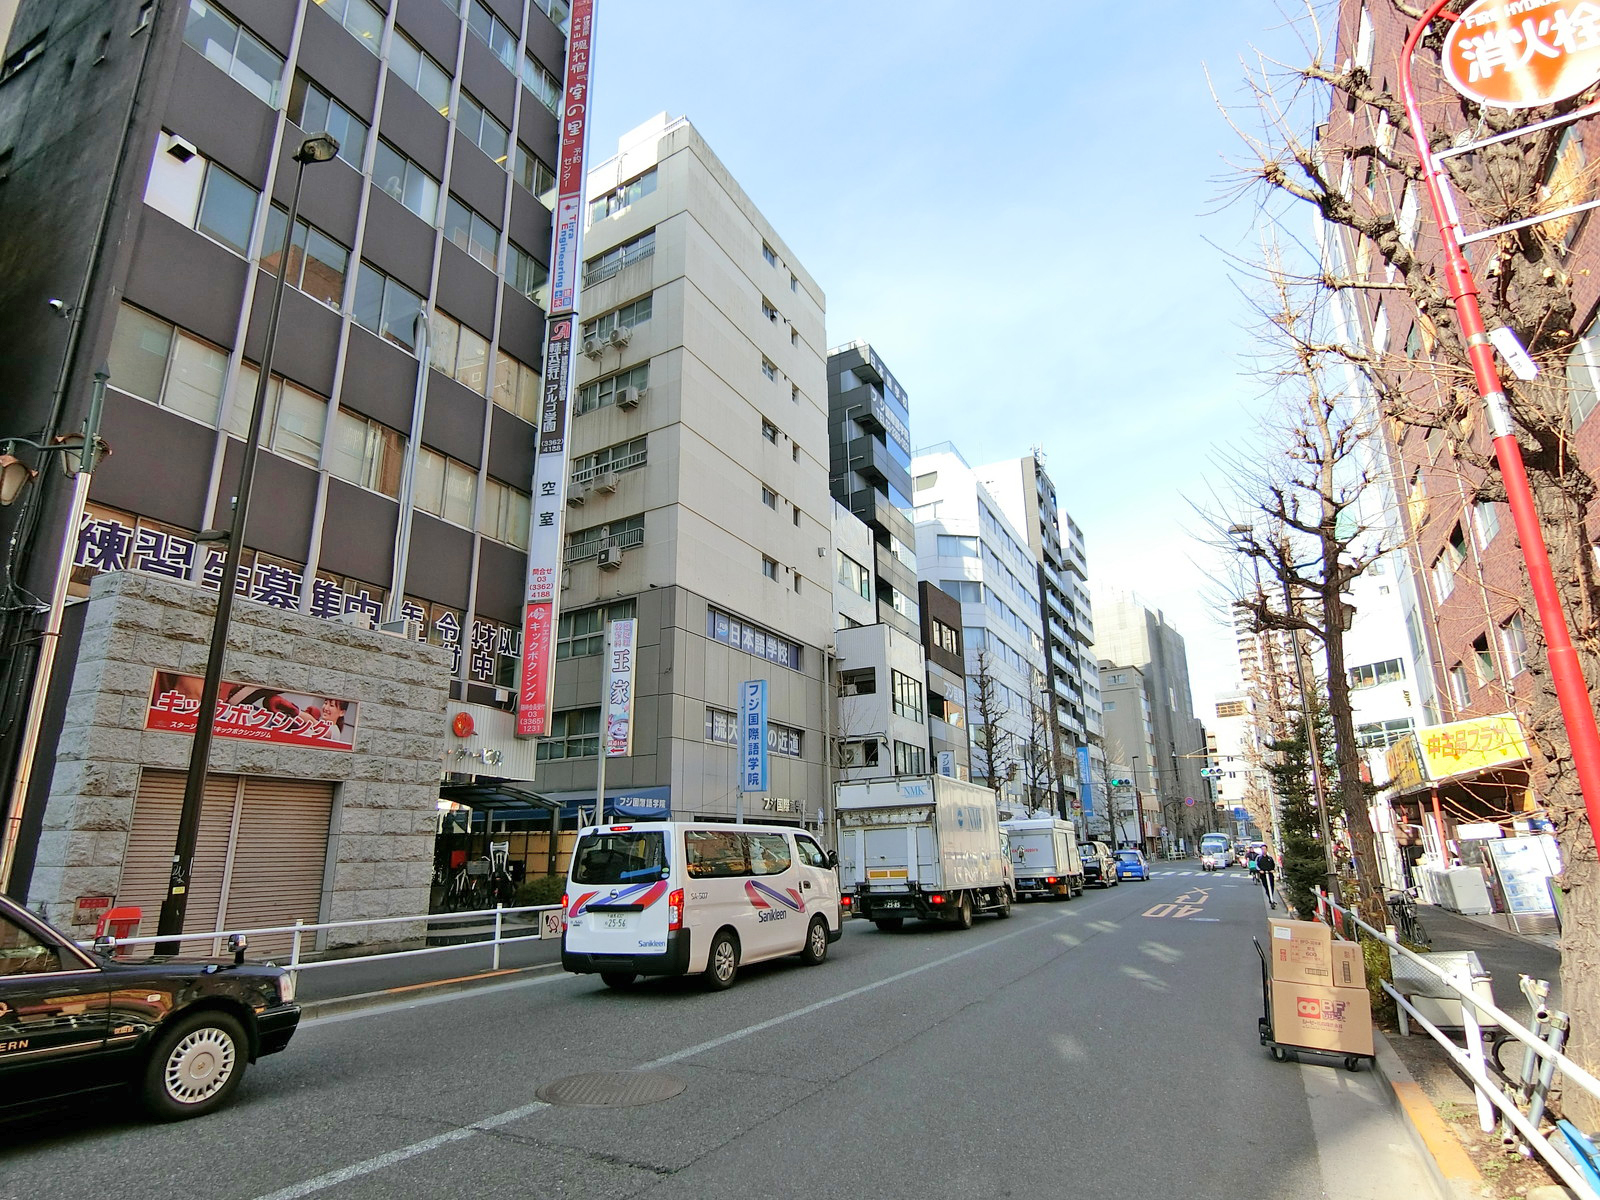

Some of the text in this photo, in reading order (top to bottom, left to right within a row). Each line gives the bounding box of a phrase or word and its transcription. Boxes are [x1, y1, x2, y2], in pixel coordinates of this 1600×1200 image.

[555, 223, 568, 288] Engineering
[547, 342, 562, 380] 株式会社
[538, 481, 556, 527] 空室
[529, 582, 554, 591] (3362)
[531, 590, 551, 598] 4188
[731, 622, 788, 665] 日本語学校
[525, 622, 541, 701] キックボクシング
[520, 718, 544, 726] (3365)
[523, 725, 540, 733] 1231
[747, 684, 761, 787] フジ国際語学院
[619, 797, 667, 809] フジ国際語学院
[758, 908, 787, 923] Sanikleen
[638, 940, 666, 948] Sanikleen
